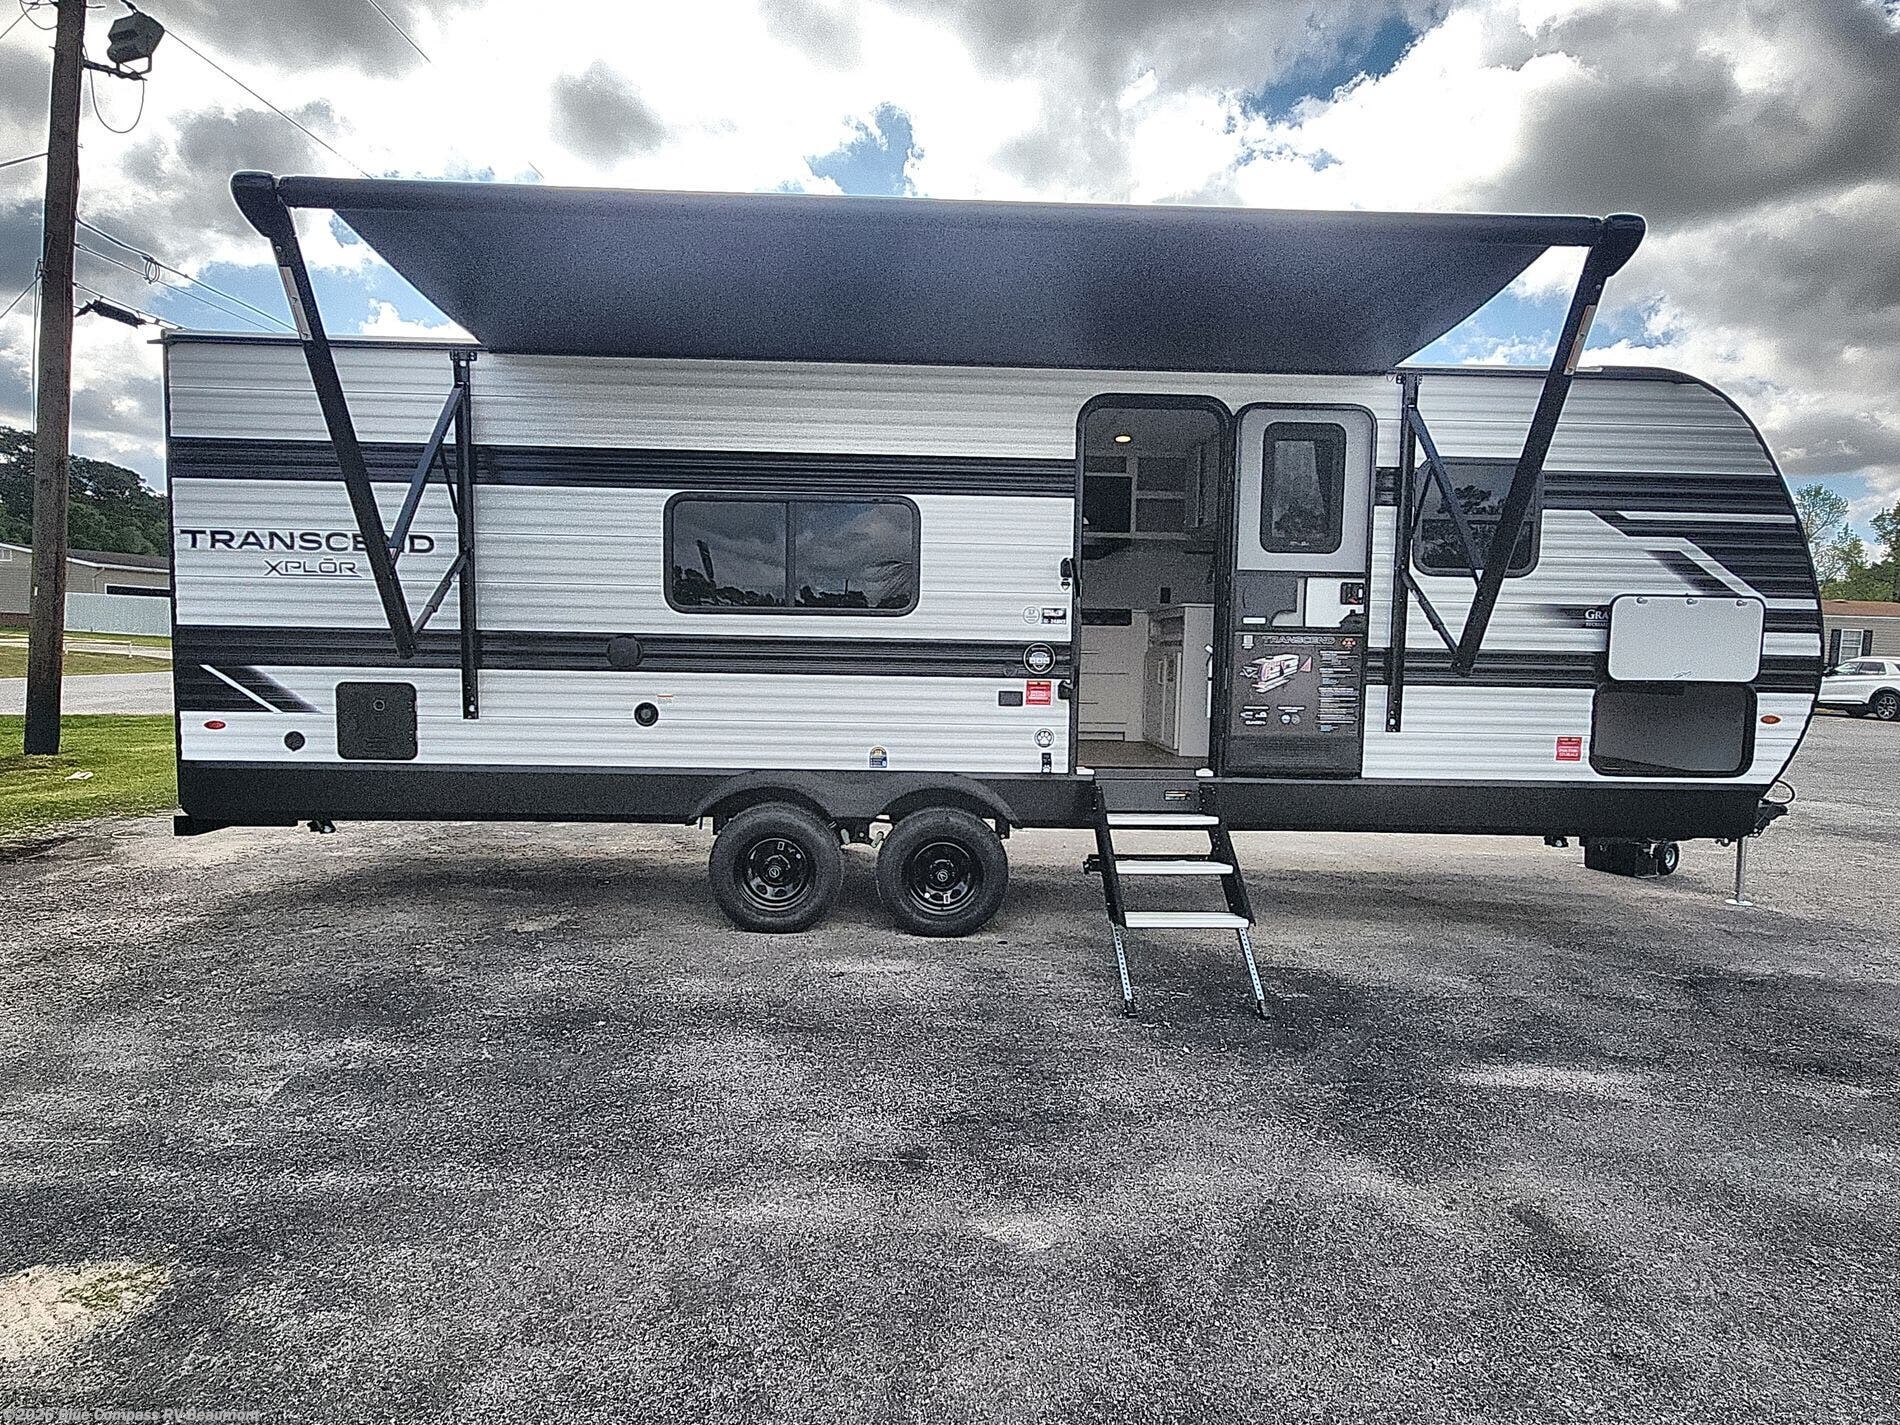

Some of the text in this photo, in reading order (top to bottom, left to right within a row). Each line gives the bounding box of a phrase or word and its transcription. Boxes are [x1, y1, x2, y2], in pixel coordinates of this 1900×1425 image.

[180, 529, 435, 553] TRANSCED
[1585, 609, 1610, 619] GRA
[1262, 635, 1335, 644] TRANSCEND
